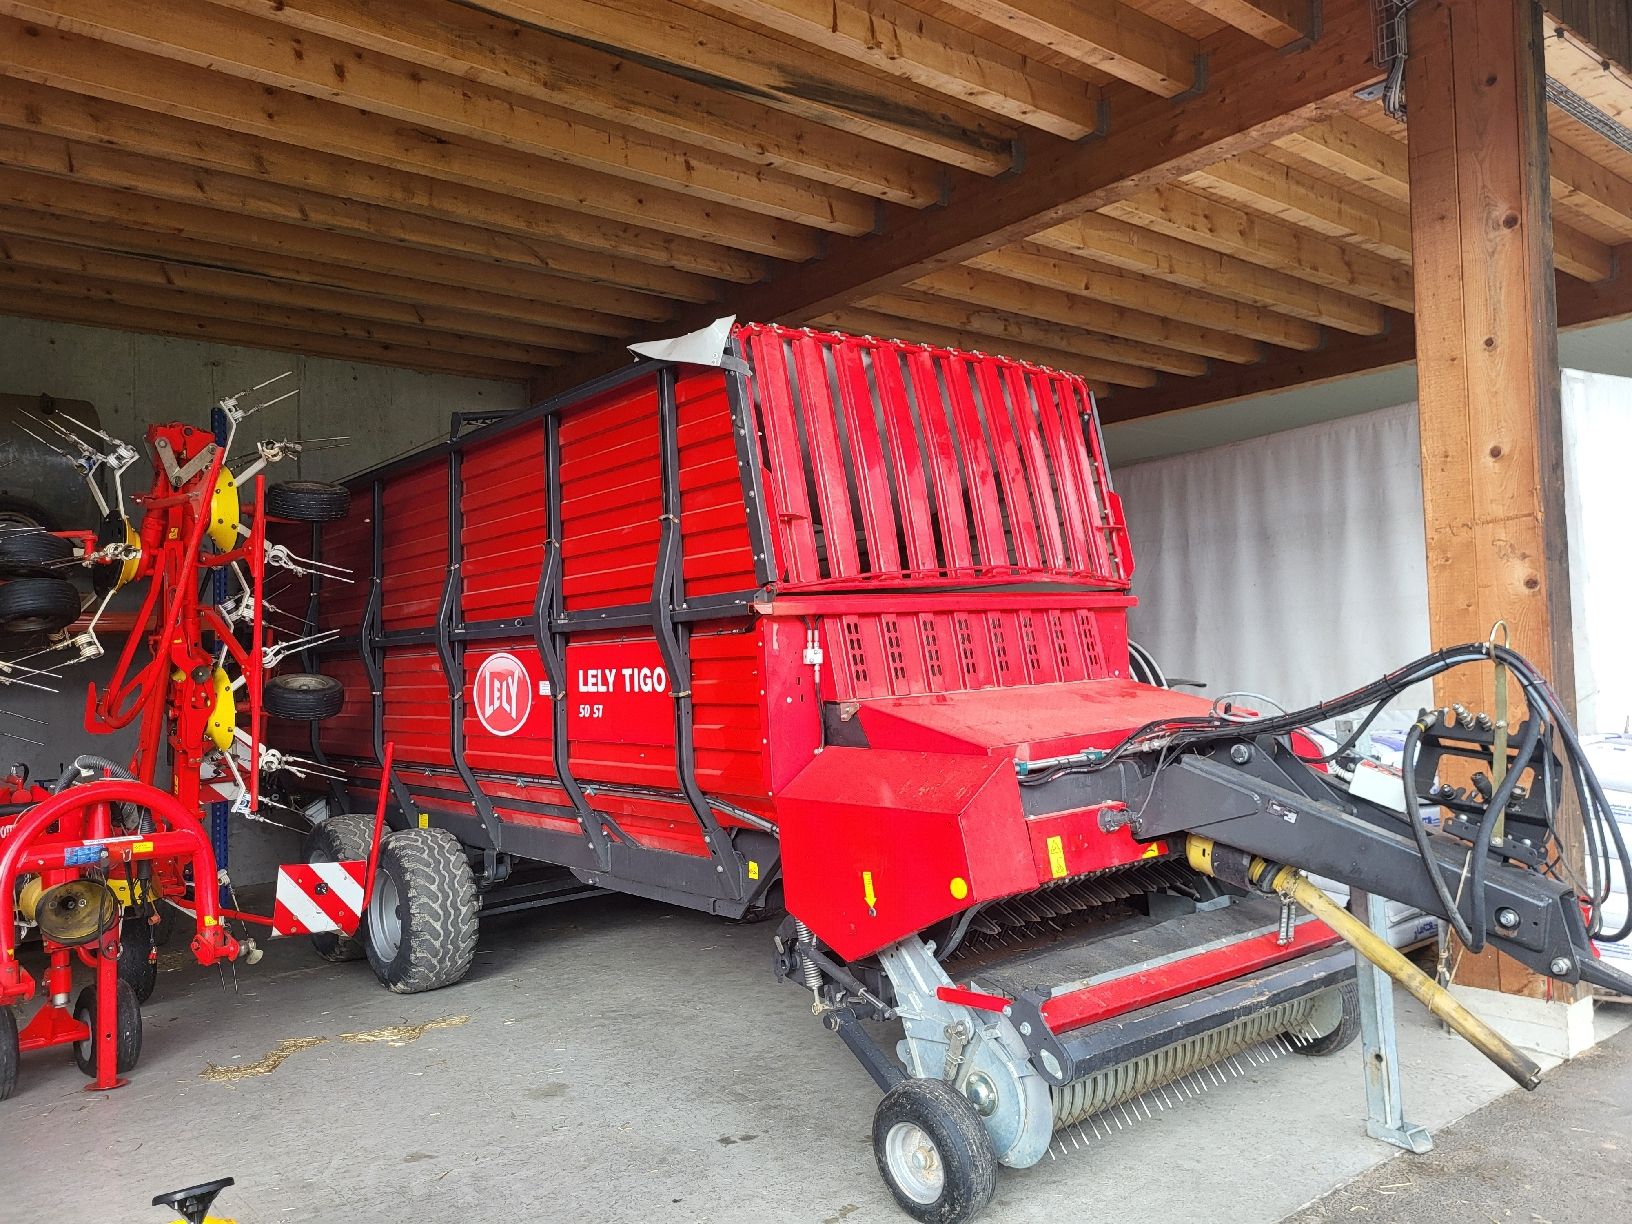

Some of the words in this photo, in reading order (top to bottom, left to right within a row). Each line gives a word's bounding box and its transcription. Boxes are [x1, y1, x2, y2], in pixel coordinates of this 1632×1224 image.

[578, 668, 617, 693] LELY
[621, 666, 666, 693] TIGO
[485, 669, 519, 720] LELY
[578, 704, 591, 718] 50
